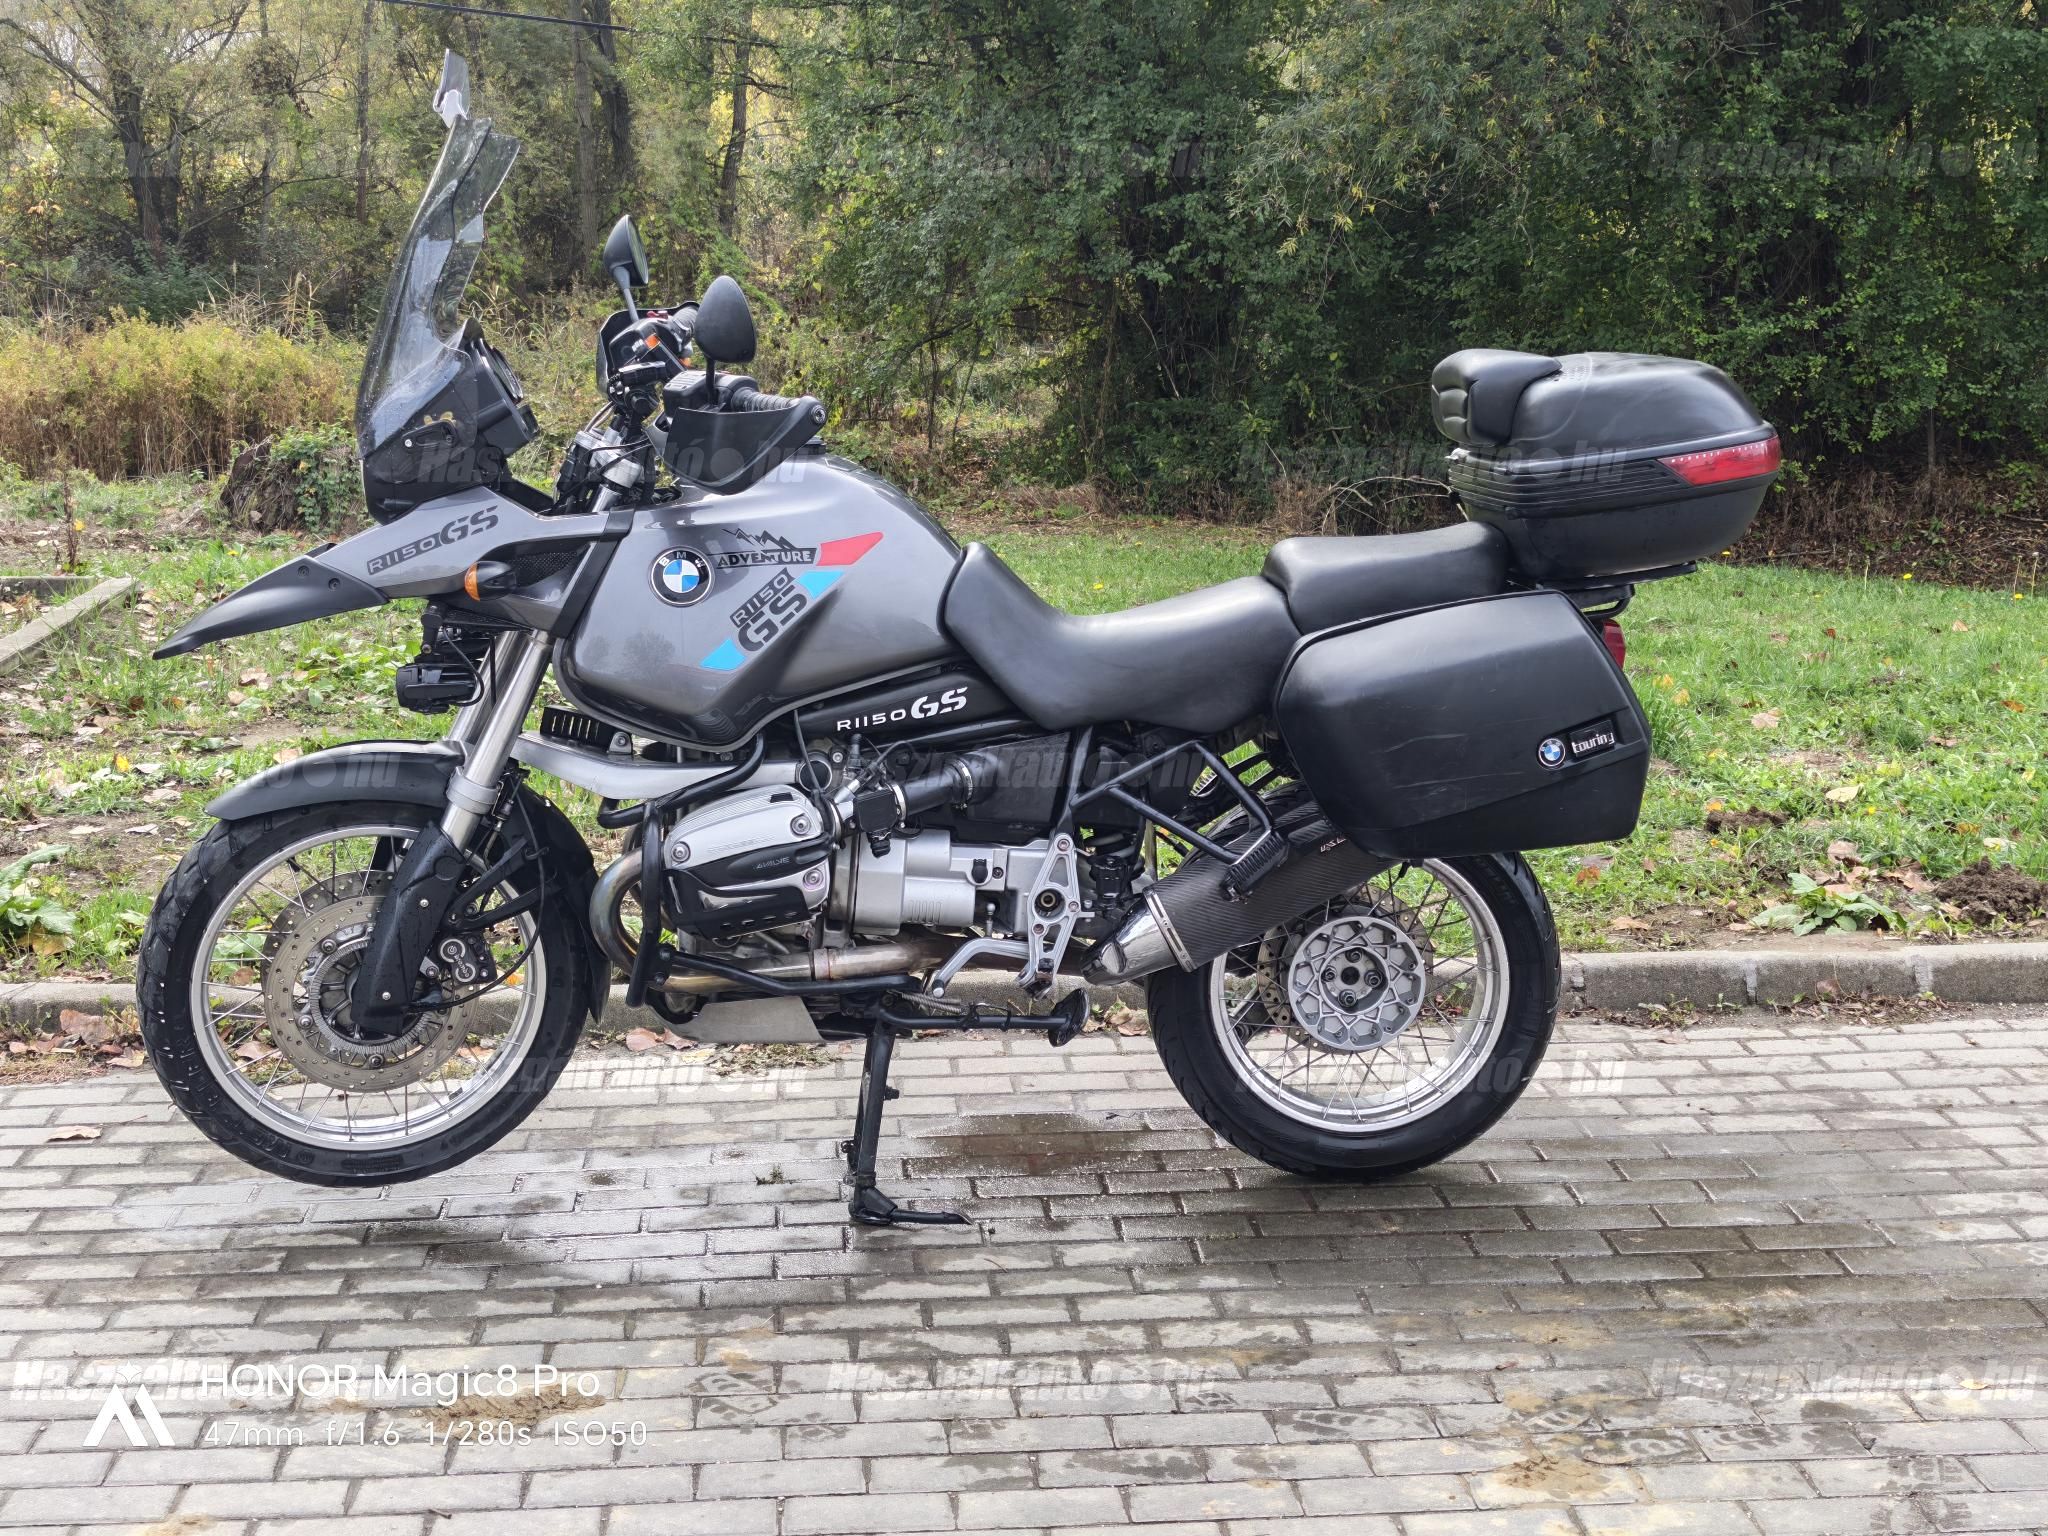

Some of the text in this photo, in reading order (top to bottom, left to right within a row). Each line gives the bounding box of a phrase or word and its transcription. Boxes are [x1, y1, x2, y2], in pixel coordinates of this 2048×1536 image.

[658, 551, 704, 568] BMW
[717, 550, 812, 568] ADVENTURE
[732, 573, 788, 627] R1150
[738, 585, 807, 651] GS
[1571, 732, 1615, 754] touring
